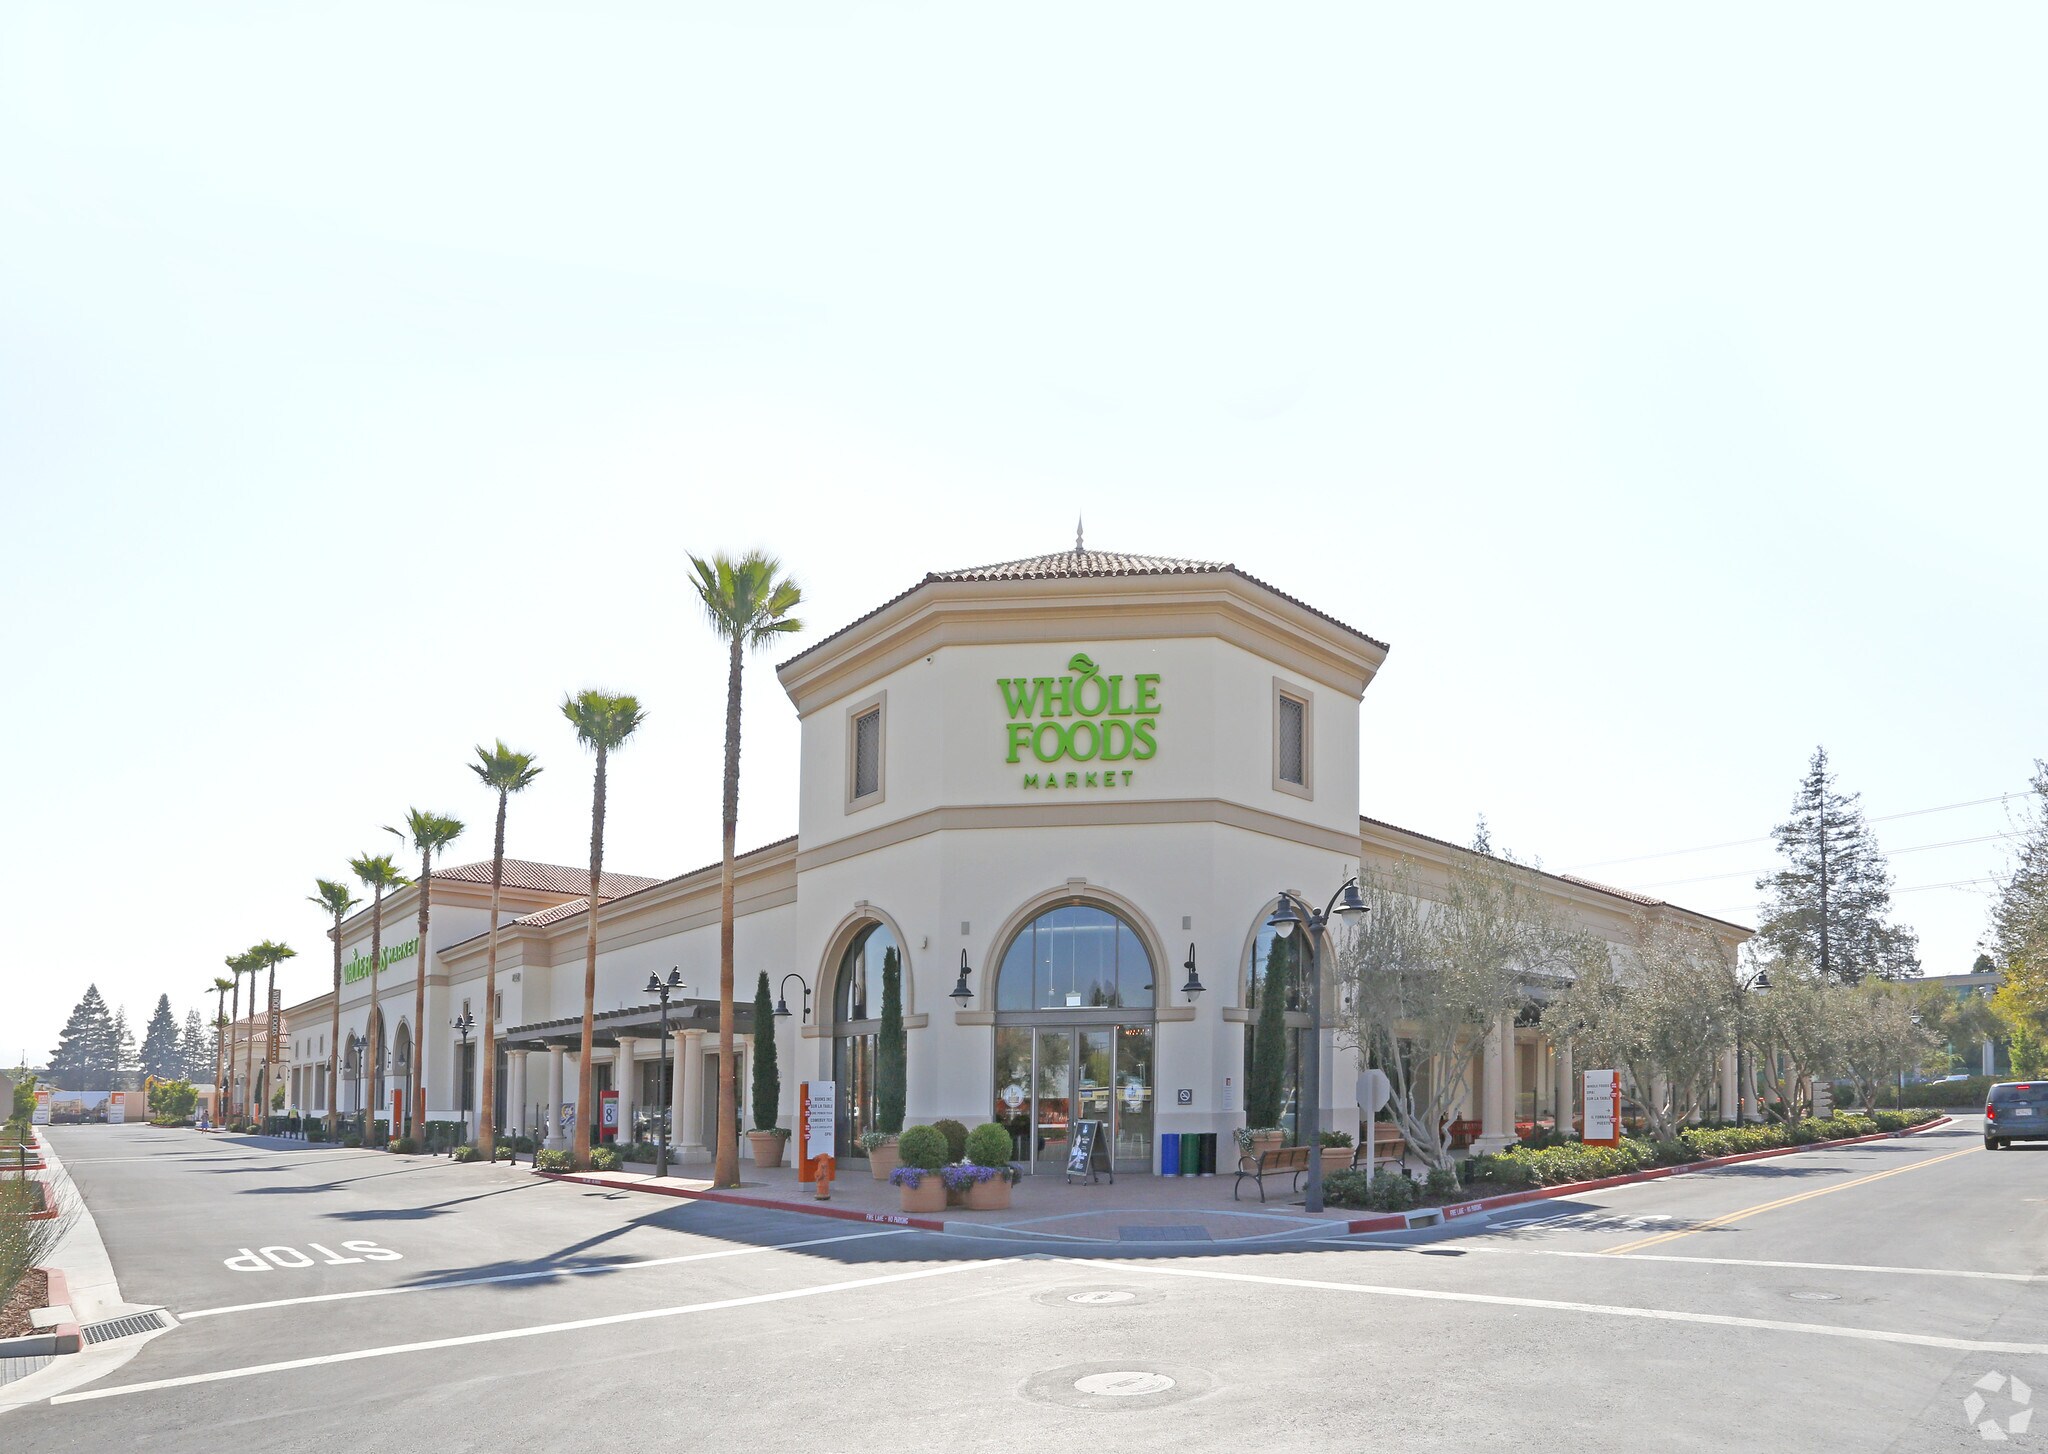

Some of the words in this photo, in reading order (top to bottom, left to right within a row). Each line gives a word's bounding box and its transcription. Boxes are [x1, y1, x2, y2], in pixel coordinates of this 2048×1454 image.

[996, 665, 1161, 719] WHOLE
[1005, 718, 1157, 763] FOODS
[1023, 770, 1133, 790] MARKET
[344, 955, 365, 985] WHOLE
[388, 936, 419, 964] MARKET
[605, 1107, 613, 1123] 8
[223, 1240, 404, 1272] STOP
